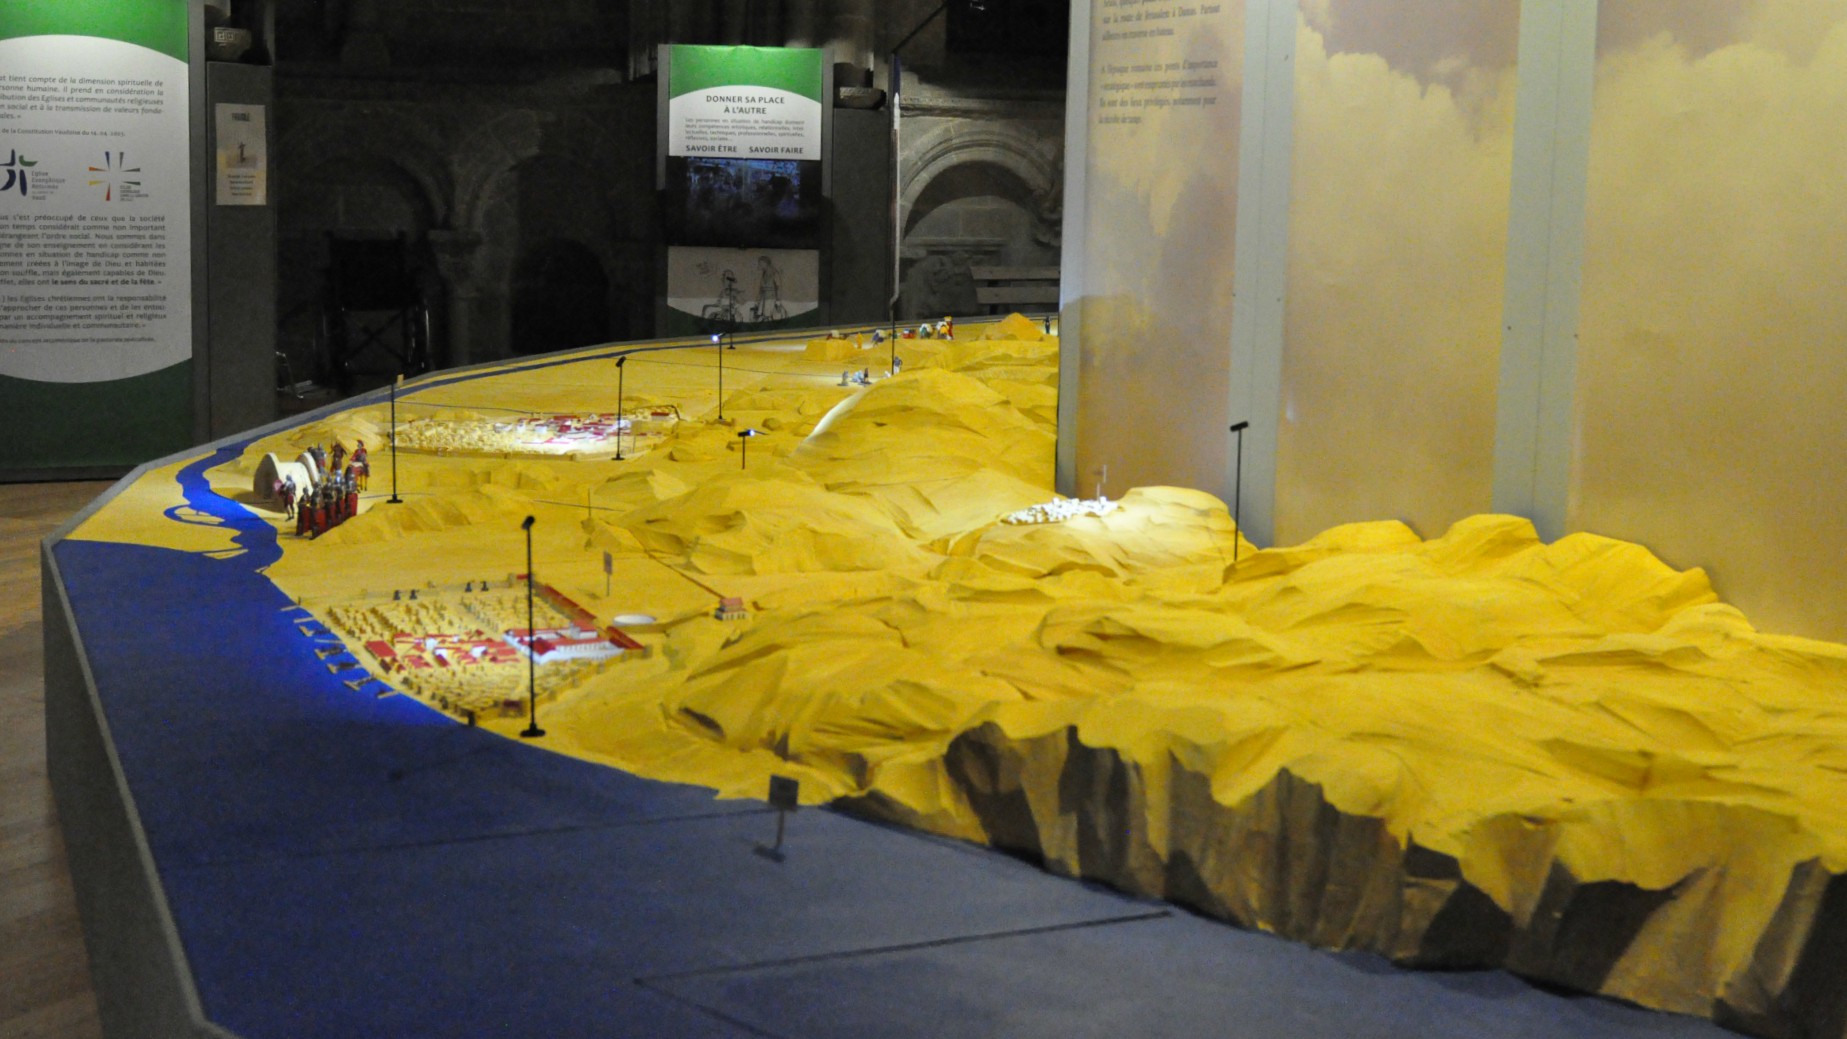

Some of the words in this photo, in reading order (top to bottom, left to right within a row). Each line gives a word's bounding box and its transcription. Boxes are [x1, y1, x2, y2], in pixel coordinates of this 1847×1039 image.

[118, 79, 152, 87] spirituelle
[718, 144, 737, 152] ÊTRE
[62, 269, 100, 277] également
